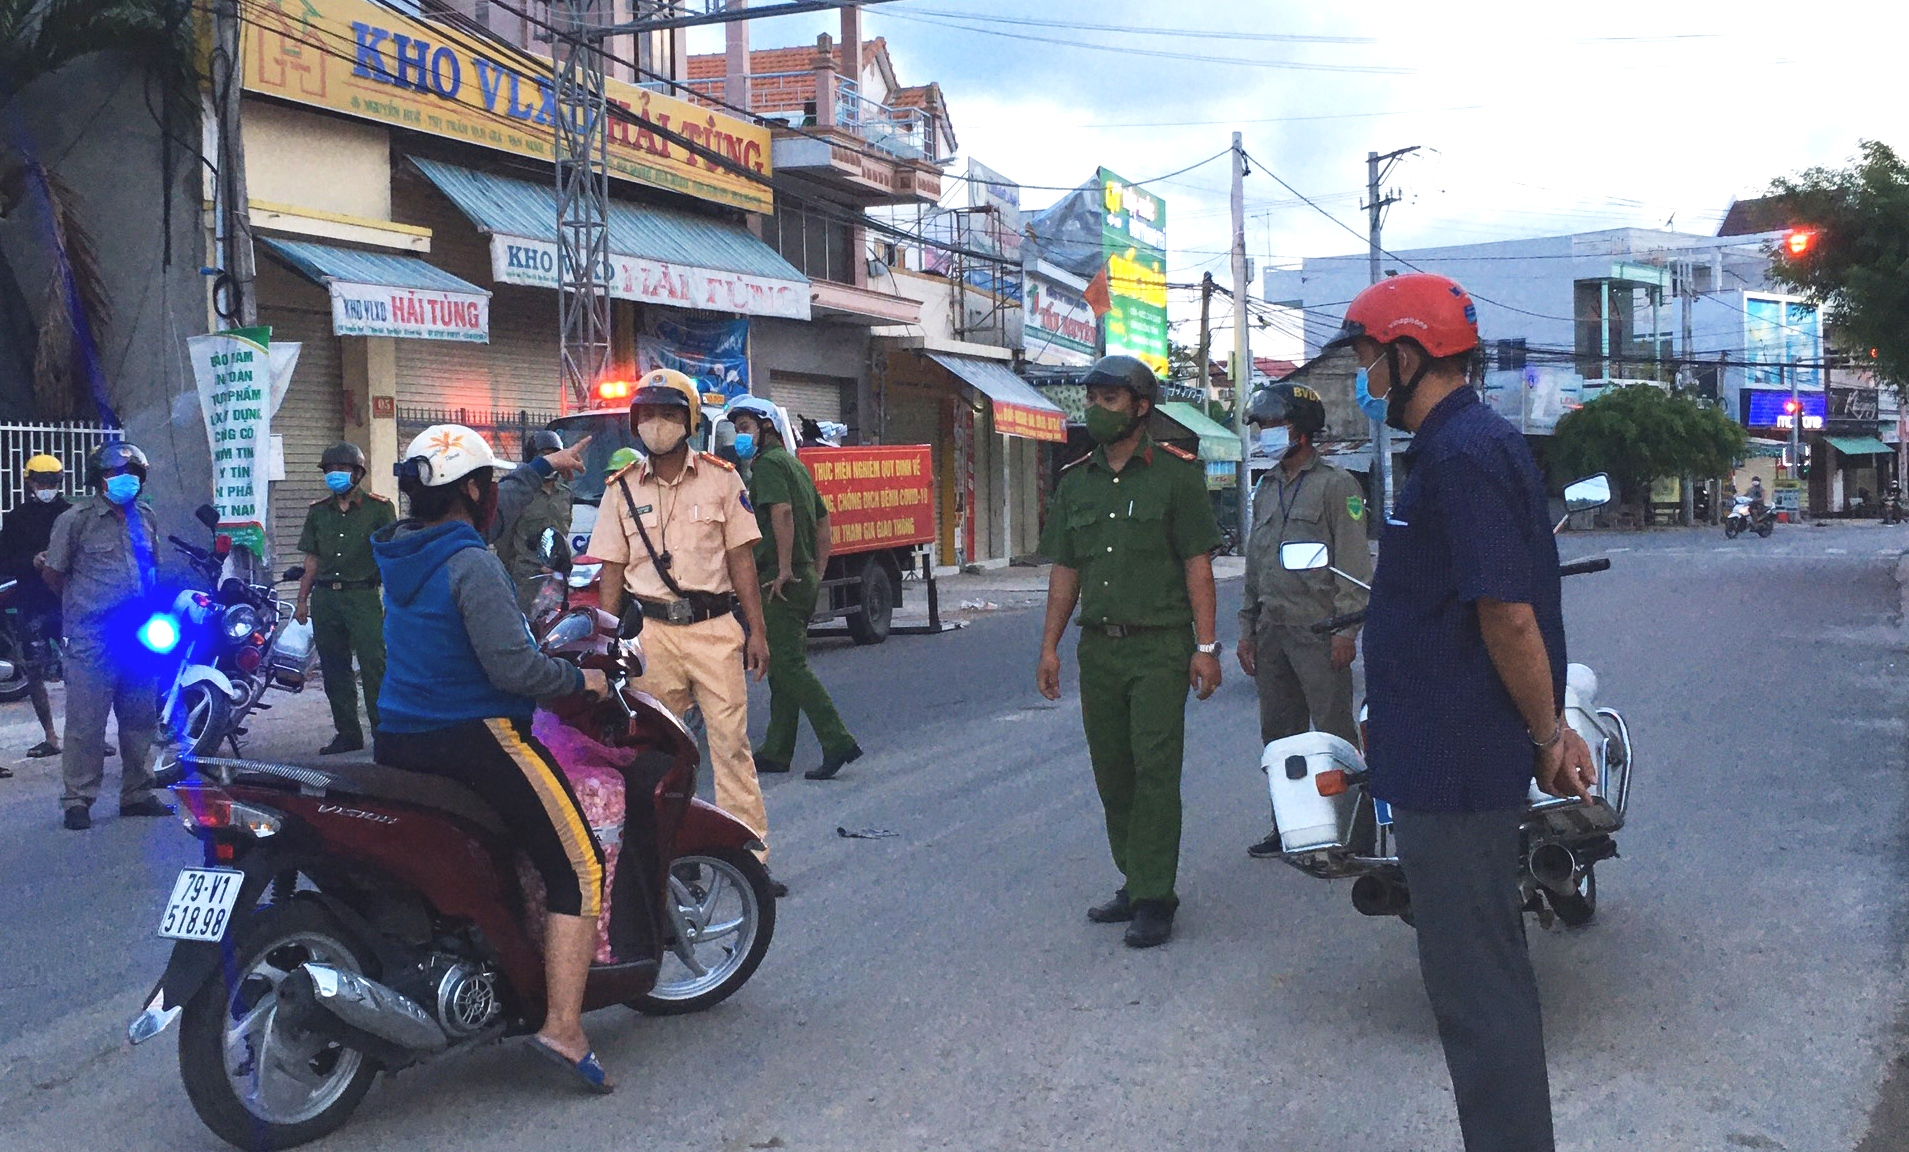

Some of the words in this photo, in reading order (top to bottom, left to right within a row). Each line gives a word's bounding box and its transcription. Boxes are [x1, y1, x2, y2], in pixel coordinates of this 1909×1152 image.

[350, 21, 461, 98] KHO
[606, 91, 671, 158] HẢI
[681, 115, 764, 177] TÙNG
[507, 245, 553, 273] KHO
[343, 299, 363, 321] KHO
[364, 301, 387, 322] VLXD
[391, 291, 425, 325] HẢI
[428, 294, 479, 329] TÙNG
[236, 447, 254, 459] TIN
[230, 464, 251, 478] TÍN
[165, 904, 226, 936] 518.98
